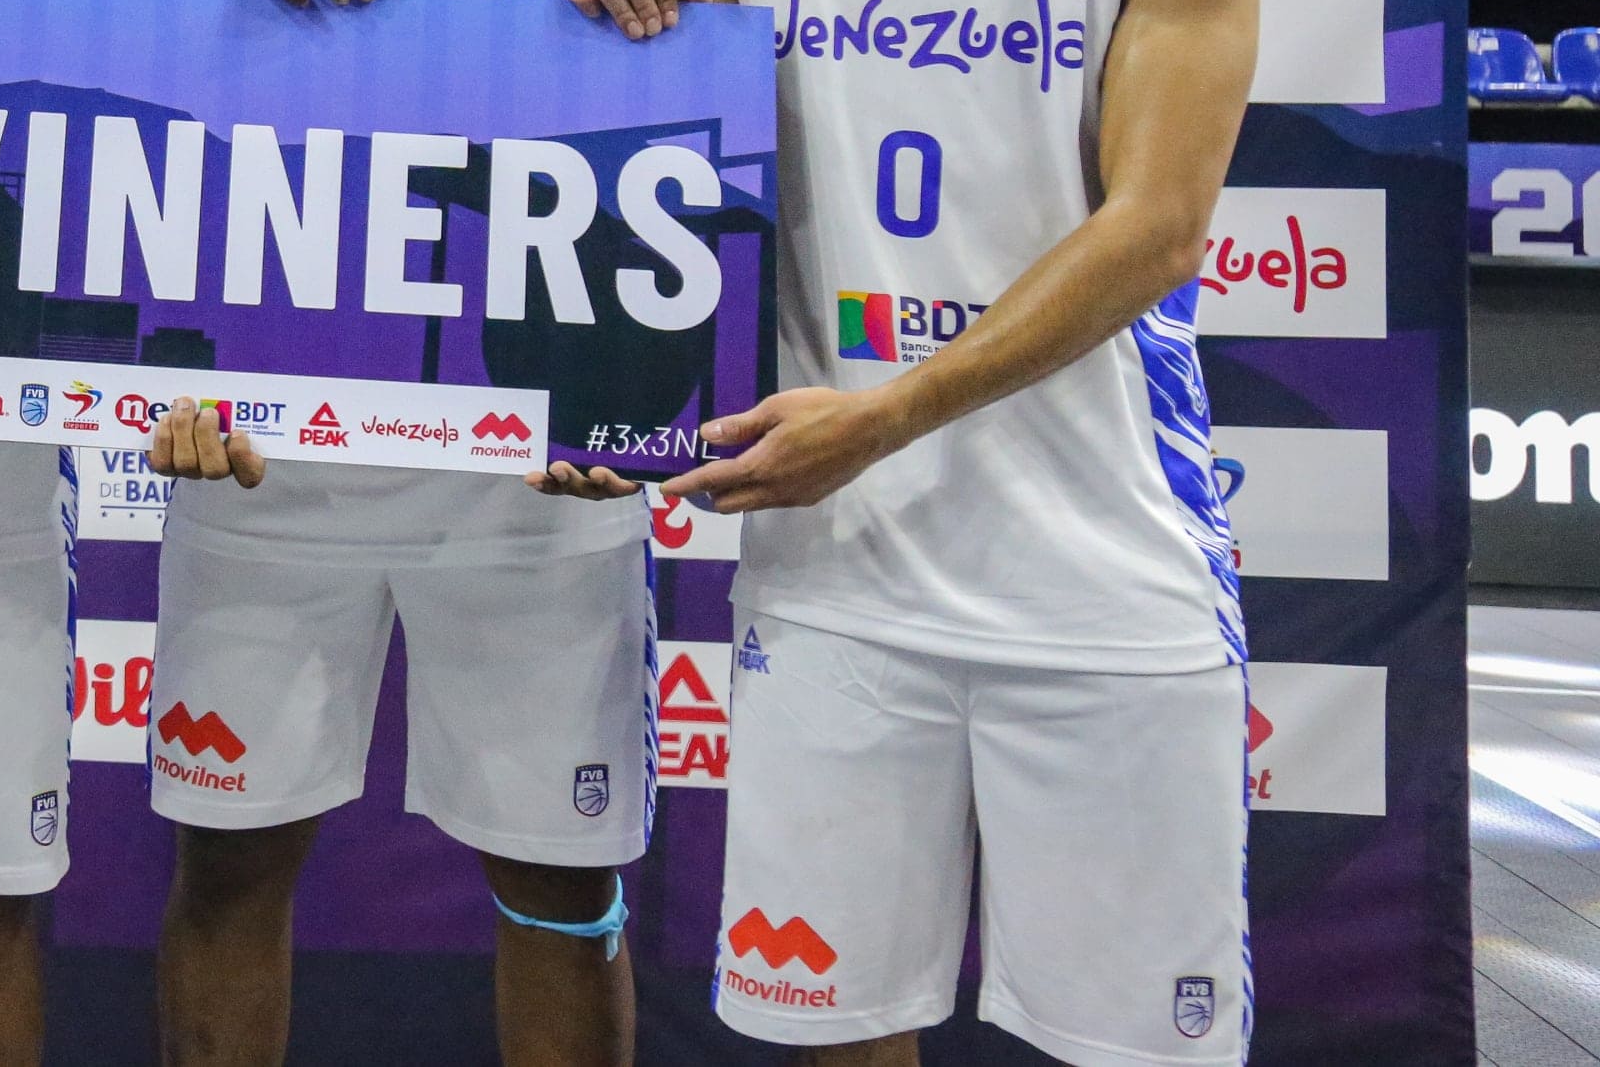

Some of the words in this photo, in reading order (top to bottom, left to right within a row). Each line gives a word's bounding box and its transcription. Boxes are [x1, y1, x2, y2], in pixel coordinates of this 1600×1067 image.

[876, 129, 943, 239] 0
[25, 388, 45, 399] FVB
[236, 401, 287, 423] BDT
[299, 428, 349, 448] PEAK
[470, 445, 532, 459] movilnet
[100, 482, 122, 498] DE
[153, 754, 247, 793] movilnet
[580, 770, 604, 782] FVB
[36, 796, 56, 810] FVB
[725, 969, 838, 1008] movilnet
[1182, 983, 1210, 996] FVB
